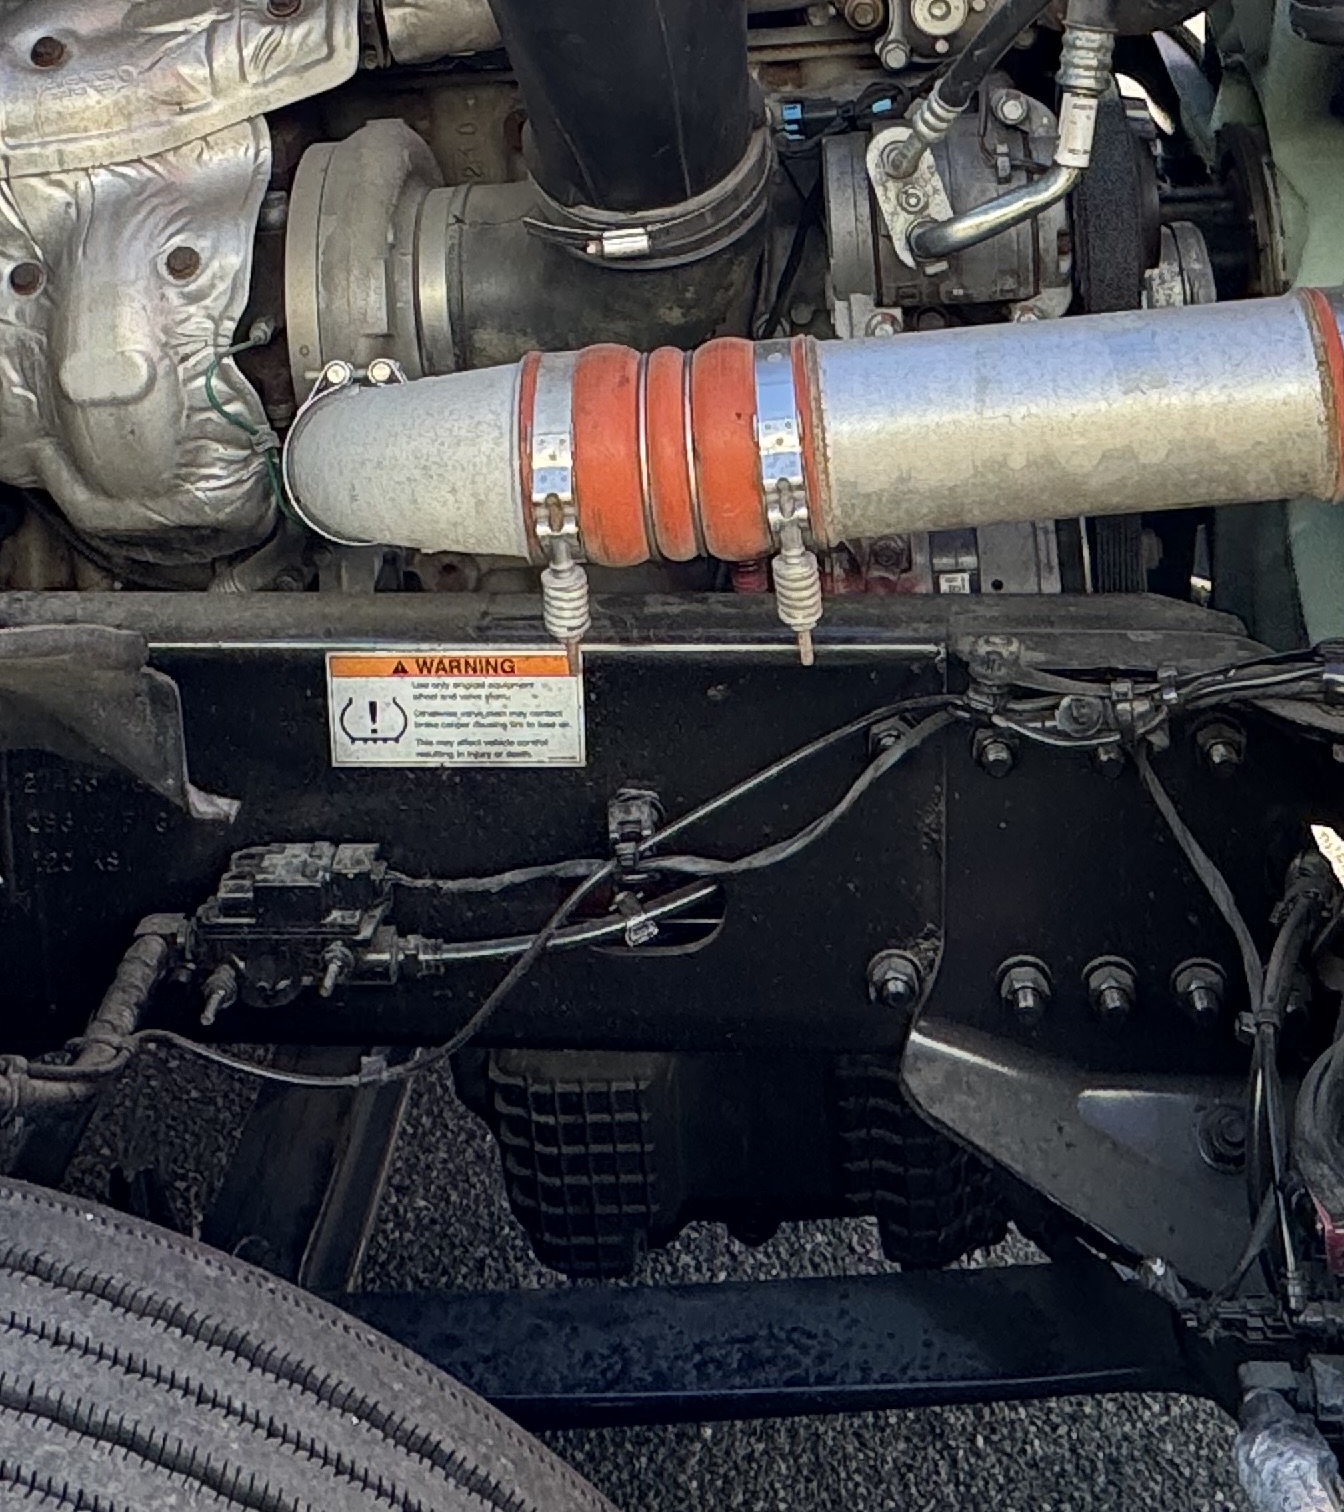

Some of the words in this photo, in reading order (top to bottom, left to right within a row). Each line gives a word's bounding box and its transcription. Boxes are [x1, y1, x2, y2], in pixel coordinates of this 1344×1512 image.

[415, 657, 516, 675] WARNING
[457, 750, 465, 758] in
[467, 750, 492, 760] injury
